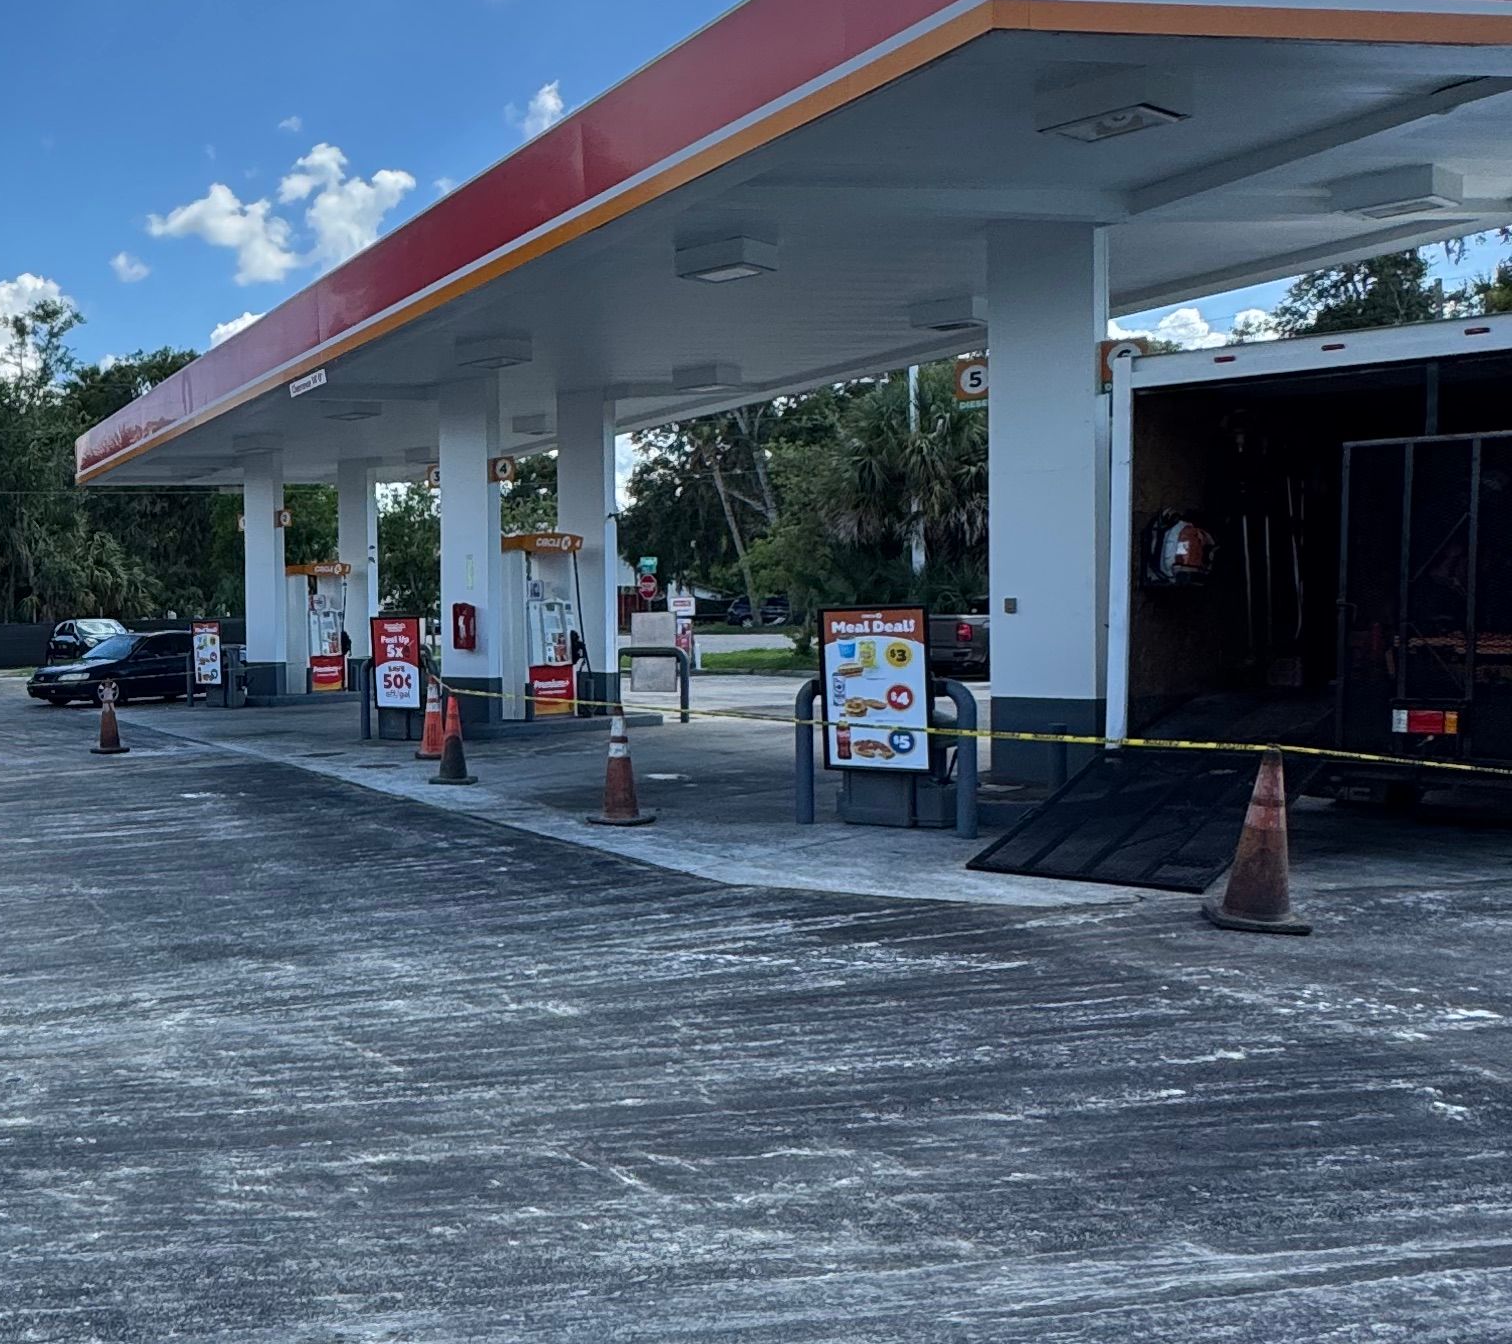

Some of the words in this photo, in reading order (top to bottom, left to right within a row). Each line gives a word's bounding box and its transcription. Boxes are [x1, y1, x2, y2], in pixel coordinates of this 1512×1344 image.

[970, 371, 982, 388] 5
[959, 399, 988, 409] DIESE
[499, 463, 507, 474] 4
[433, 470, 440, 482] 3
[536, 538, 560, 547] CIRCLE
[832, 621, 870, 633] Meal
[386, 644, 404, 658] 5x
[889, 648, 908, 662] $3
[383, 673, 412, 690] 50¢
[891, 692, 909, 706] $4
[893, 735, 910, 749] $5
